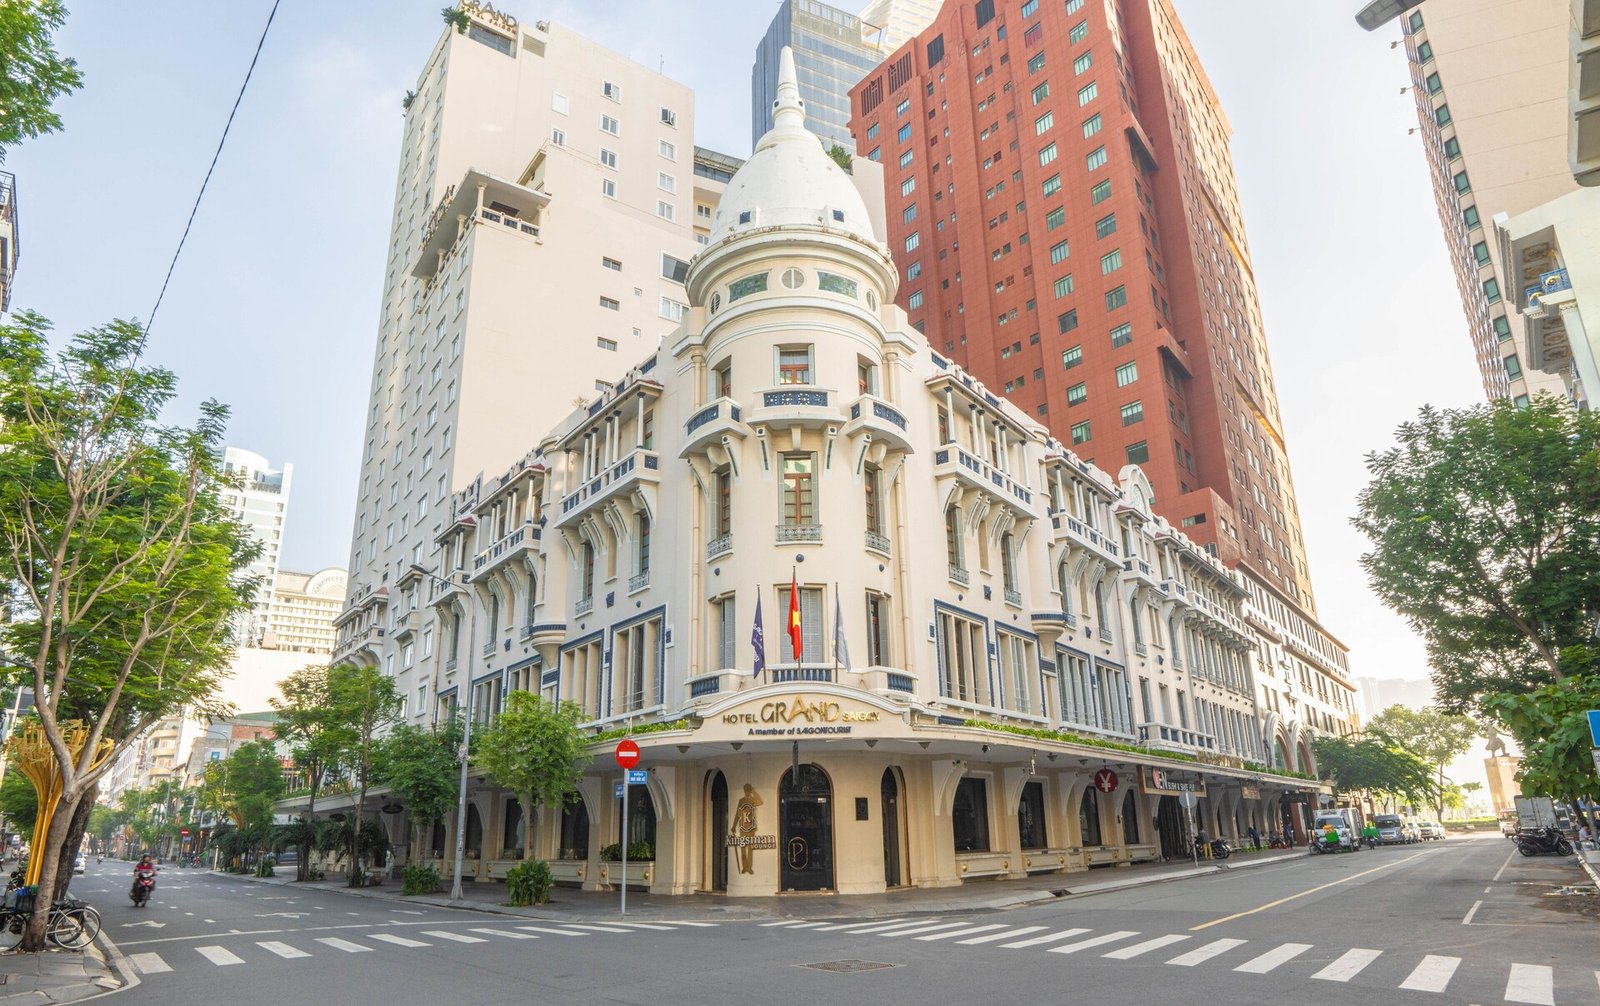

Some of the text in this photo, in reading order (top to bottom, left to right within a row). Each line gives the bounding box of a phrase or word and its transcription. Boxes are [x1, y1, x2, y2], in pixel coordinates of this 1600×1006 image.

[462, 0, 518, 28] GRAND
[722, 694, 880, 724] HOTEL GRAND SAIGON
[748, 728, 755, 736] A
[755, 728, 786, 736] member
[787, 727, 795, 735] of
[726, 834, 776, 848] Kingsman
